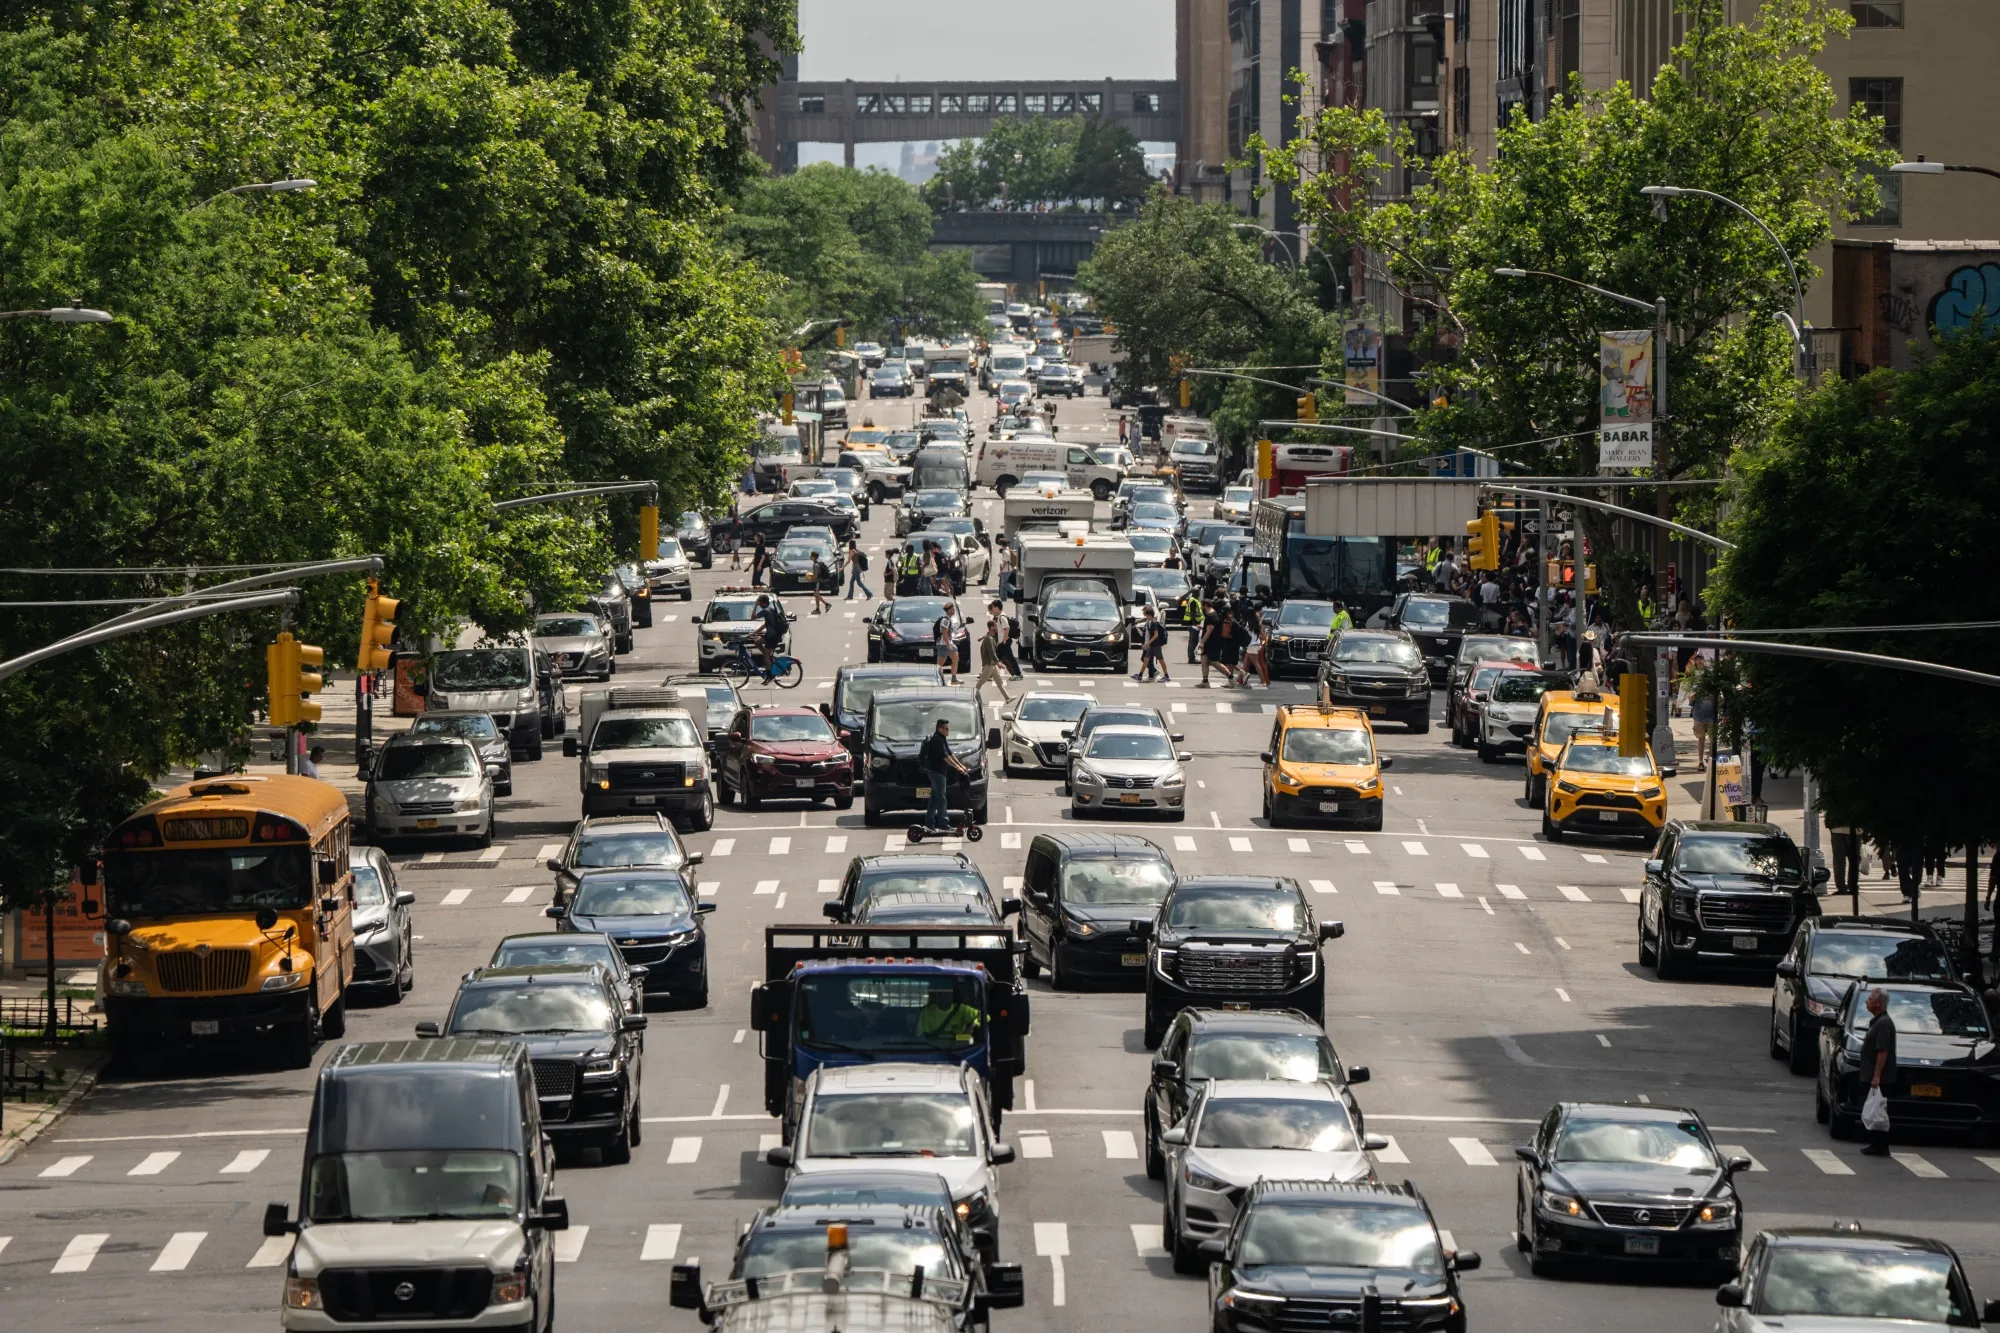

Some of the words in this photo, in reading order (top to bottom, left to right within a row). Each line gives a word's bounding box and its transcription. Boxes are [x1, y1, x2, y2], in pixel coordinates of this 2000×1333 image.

[1603, 431, 1649, 442] BABAR
[1032, 506, 1066, 515] verizon
[1719, 784, 1742, 793] Office
